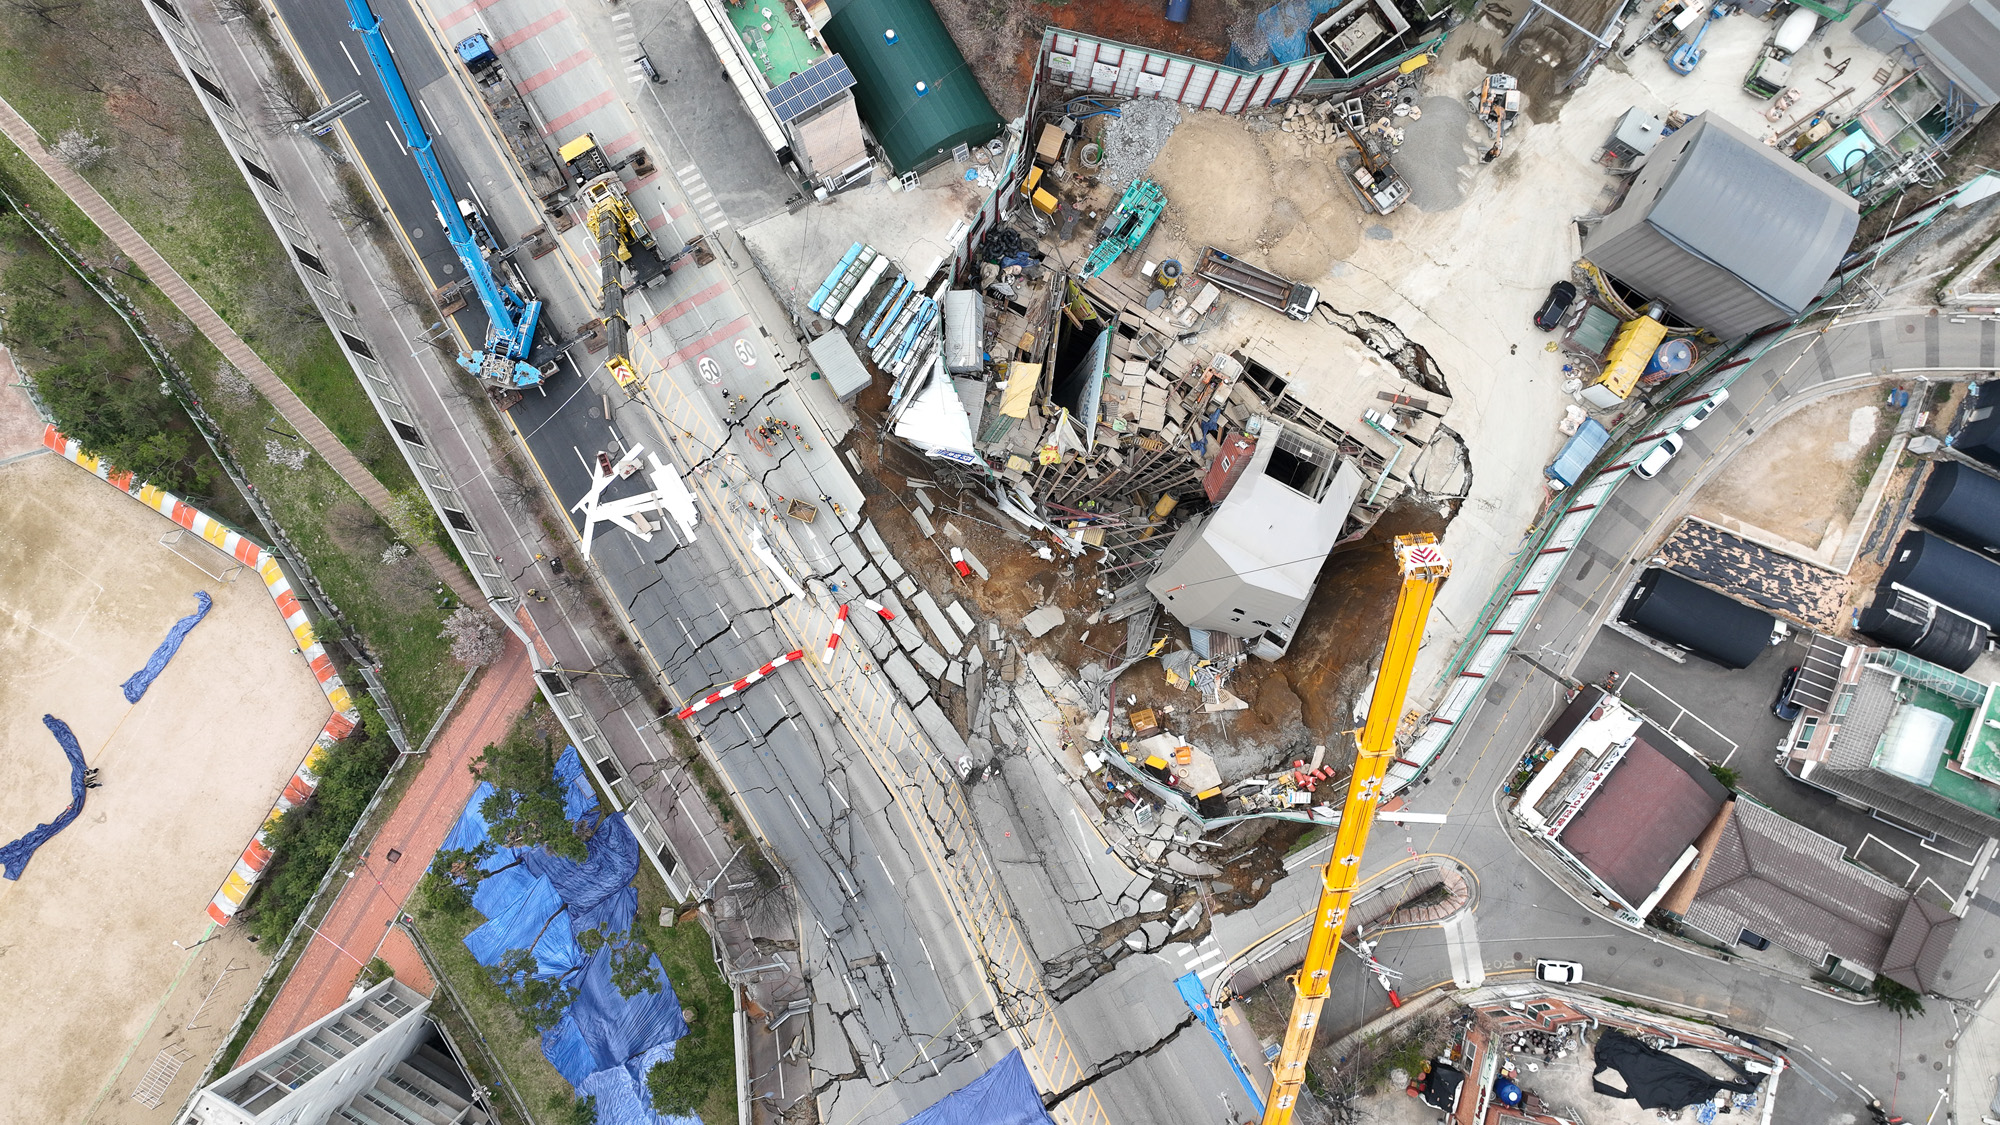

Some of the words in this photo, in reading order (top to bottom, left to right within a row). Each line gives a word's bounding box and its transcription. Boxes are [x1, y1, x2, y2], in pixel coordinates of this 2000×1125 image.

[735, 341, 756, 363] 50
[700, 360, 720, 382] 50
[1547, 772, 1603, 836] 생선구이전문점
